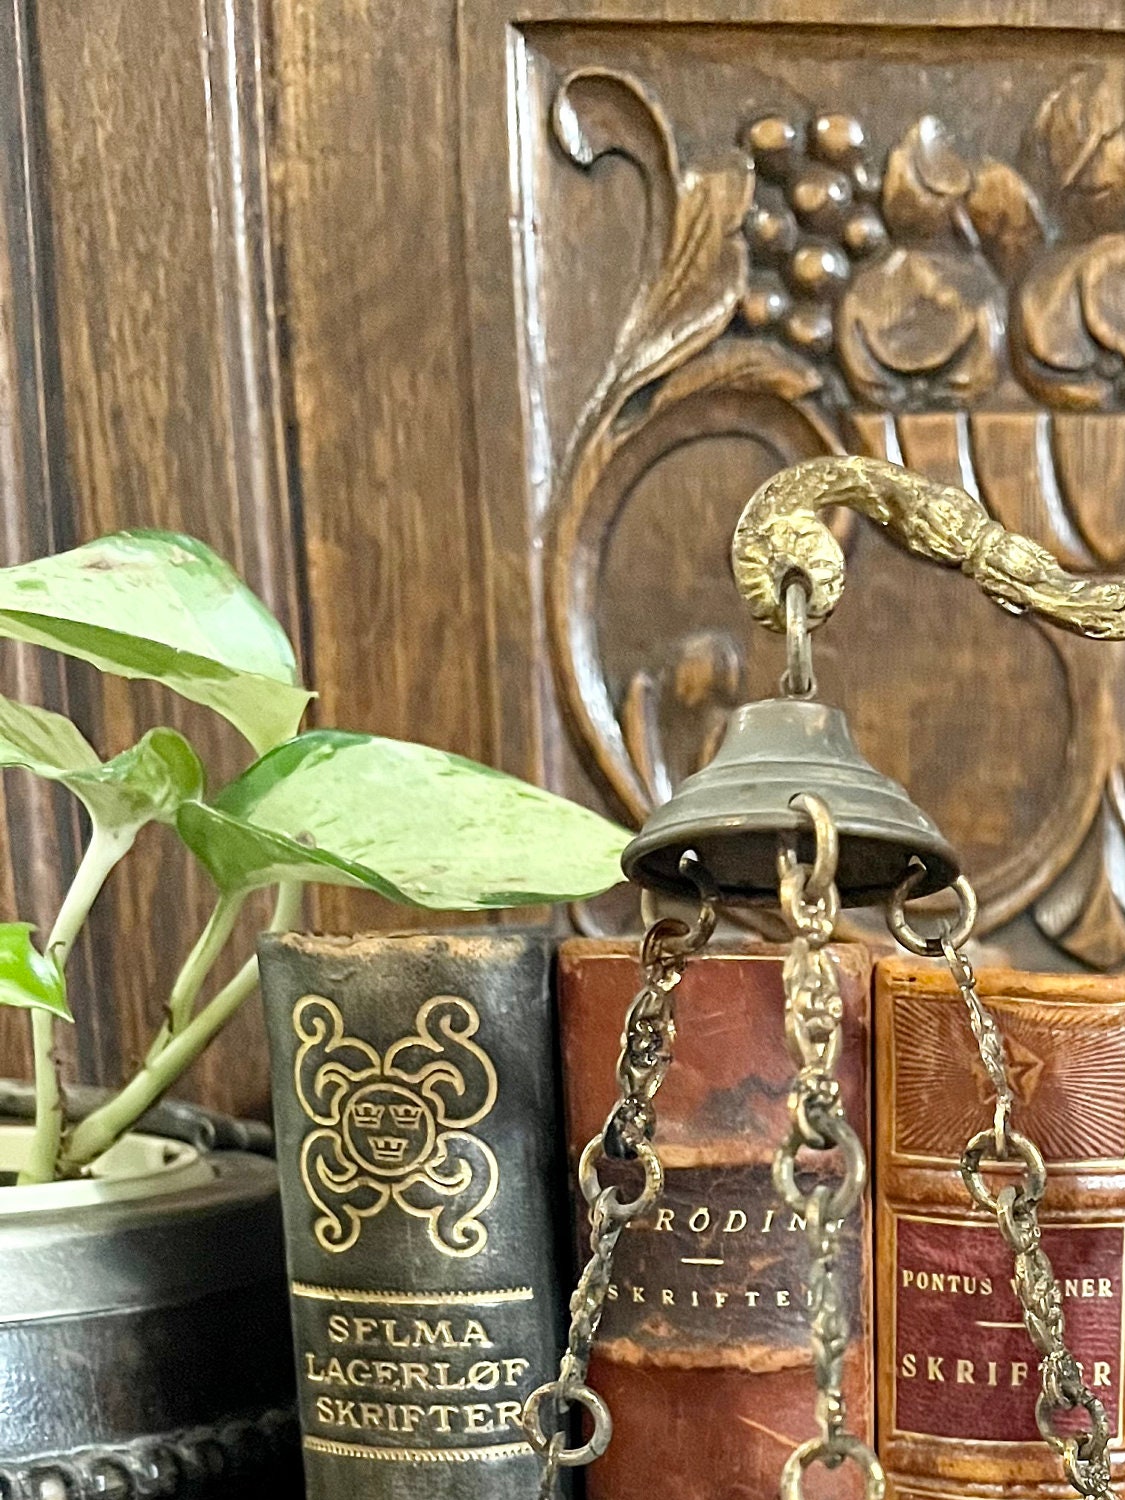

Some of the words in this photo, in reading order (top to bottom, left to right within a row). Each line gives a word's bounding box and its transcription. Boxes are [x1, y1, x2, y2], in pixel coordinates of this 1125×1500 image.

[624, 1208, 845, 1233] RÖDIN
[902, 1269, 993, 1296] PONTUS
[328, 1314, 495, 1348] SELMA
[305, 1353, 530, 1391] LAGERLØF
[902, 1353, 1112, 1387] SKRIFR
[316, 1397, 524, 1434] SKRIFTER
